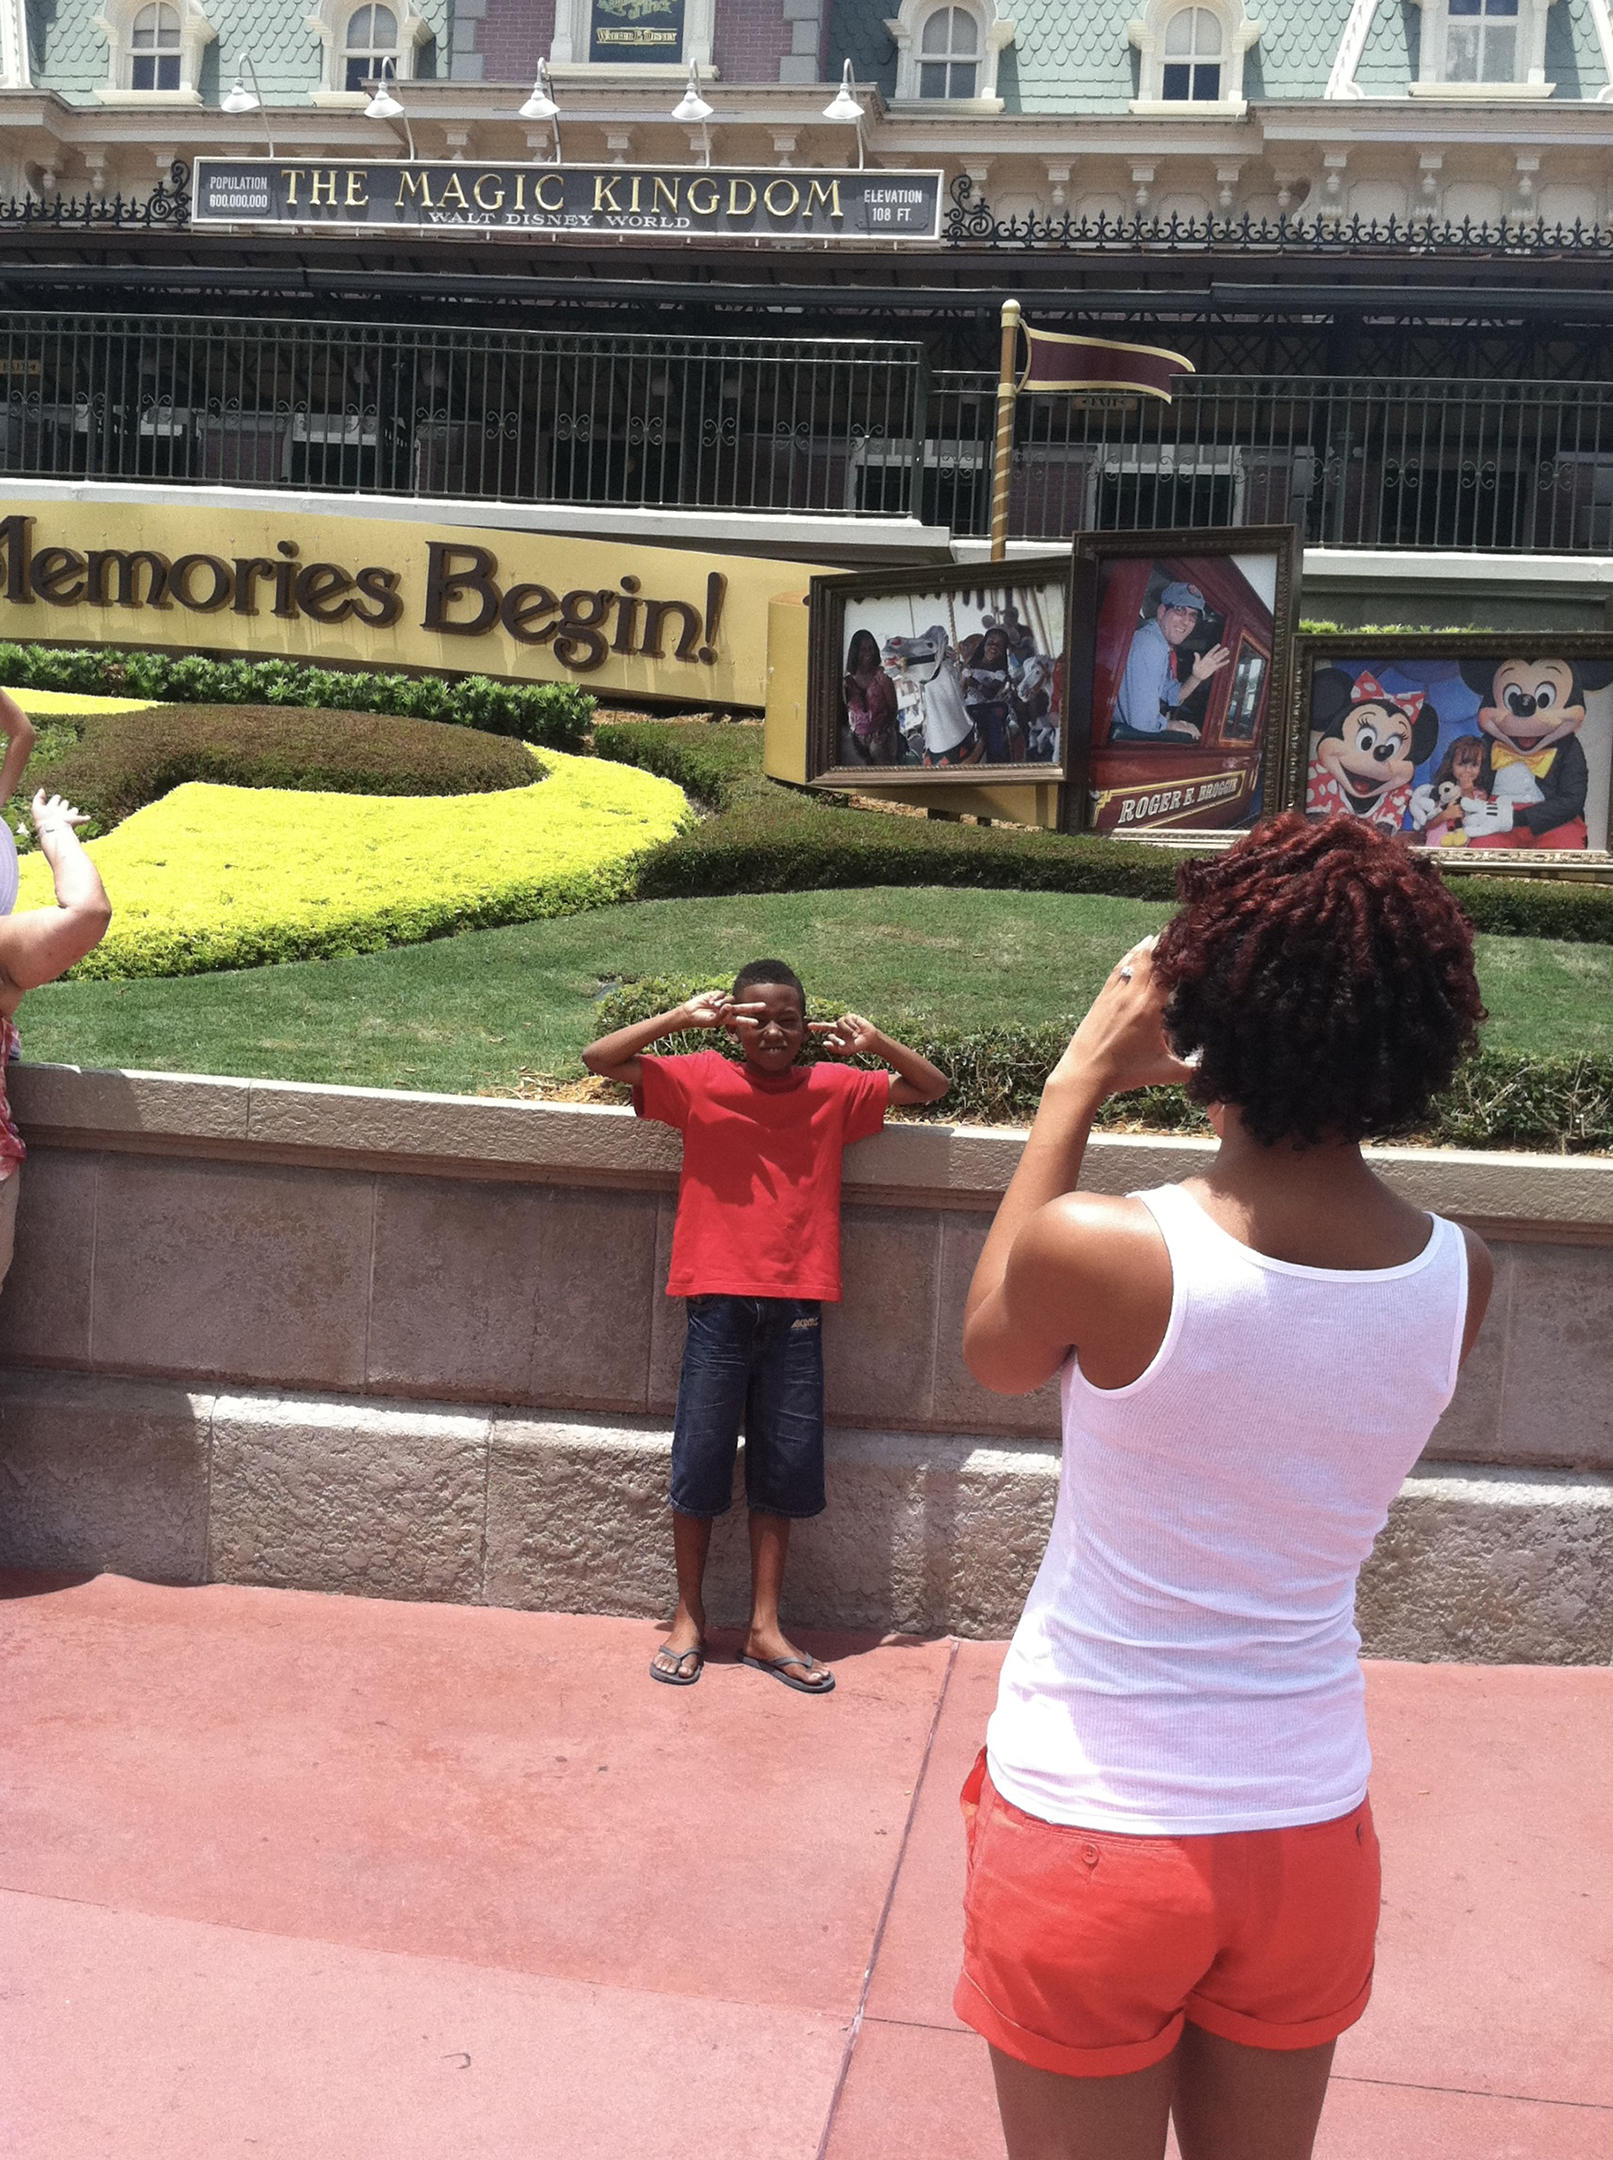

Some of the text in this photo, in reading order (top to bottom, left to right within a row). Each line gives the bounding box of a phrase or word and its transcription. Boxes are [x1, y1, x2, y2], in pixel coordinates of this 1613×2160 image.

[209, 176, 268, 190] POPULATION
[209, 194, 268, 209] 600,000,000
[280, 169, 844, 218] THE MAGIC KINGDOM
[863, 189, 923, 204] ELEVATION
[429, 211, 691, 229] WALT DISNEY WORLD
[872, 207, 891, 222] 108
[420, 540, 728, 672] Begin!
[1118, 790, 1182, 824] ROGER
[1183, 788, 1195, 806] E.
